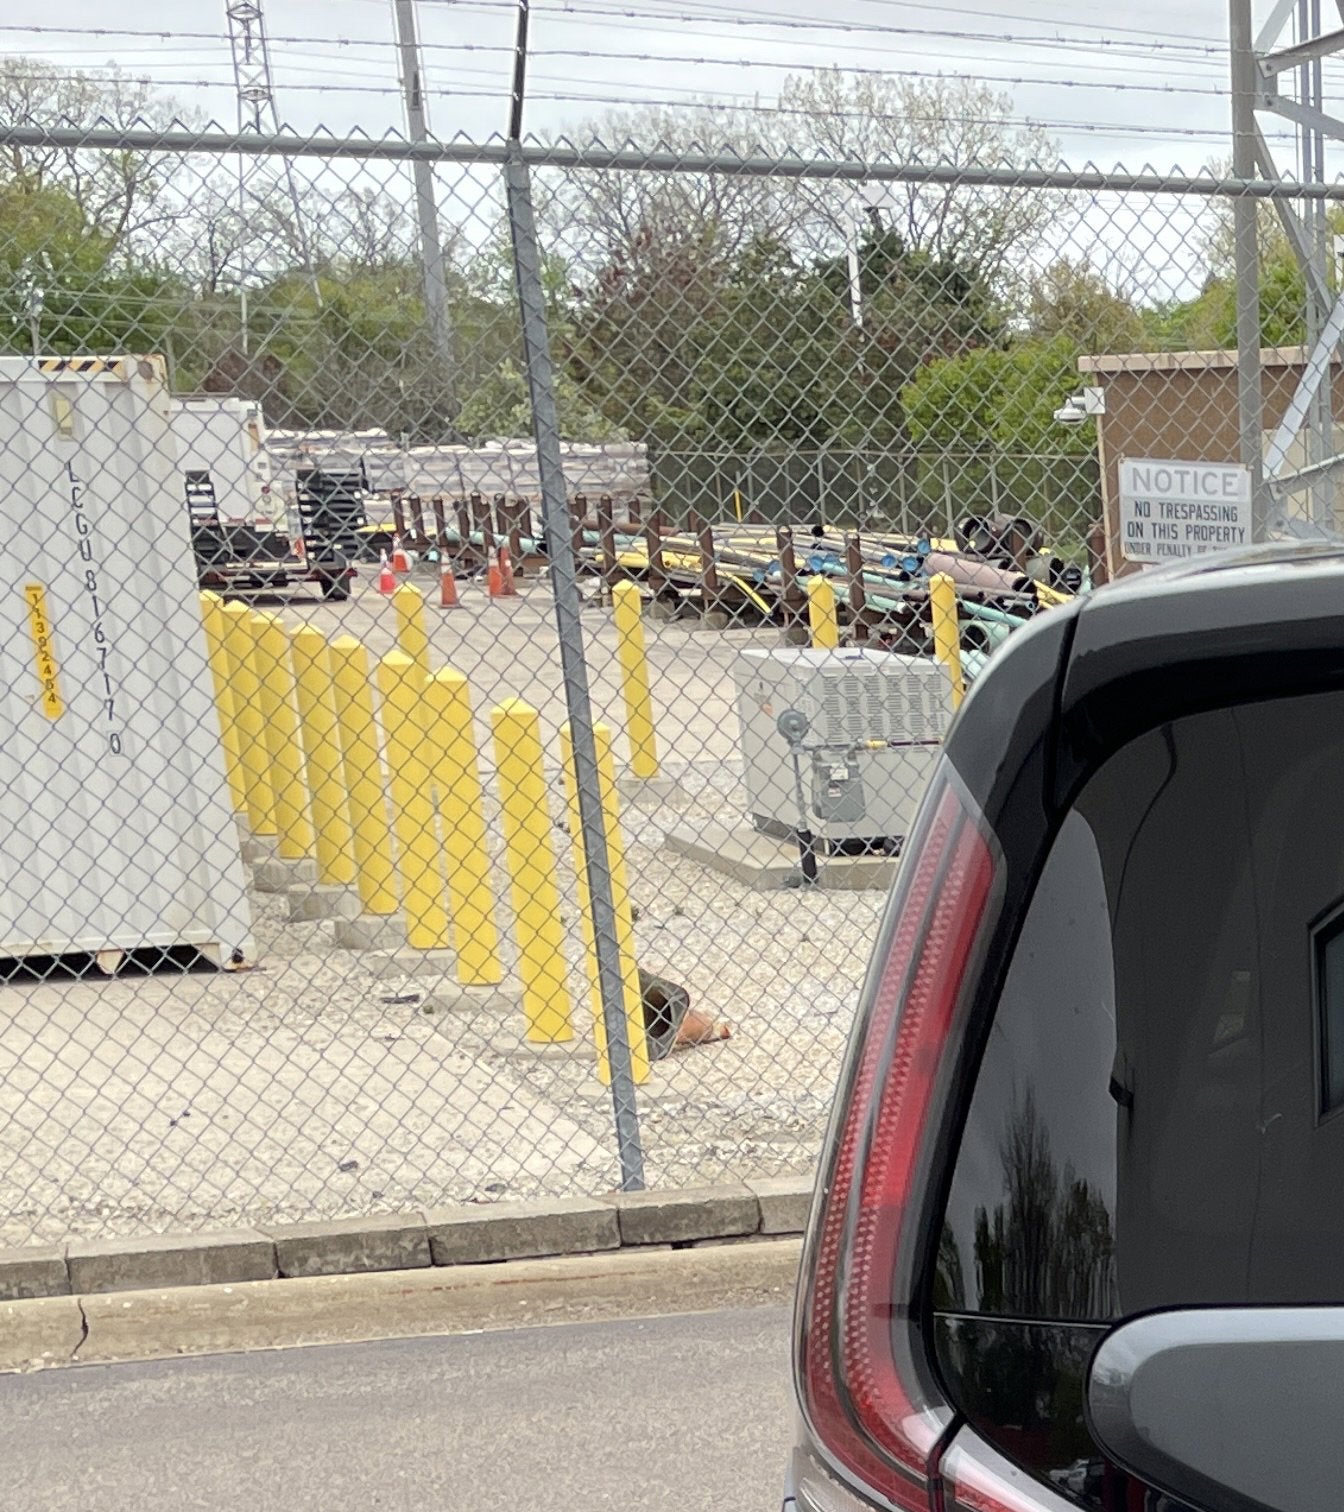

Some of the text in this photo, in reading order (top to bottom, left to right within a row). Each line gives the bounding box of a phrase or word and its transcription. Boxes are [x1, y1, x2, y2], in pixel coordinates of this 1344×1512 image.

[1132, 467, 1239, 497] NOTICE
[66, 461, 91, 561] LCGU
[1134, 501, 1238, 522] NO TRESPASSING
[1127, 521, 1245, 544] ON THIS PROPERTY
